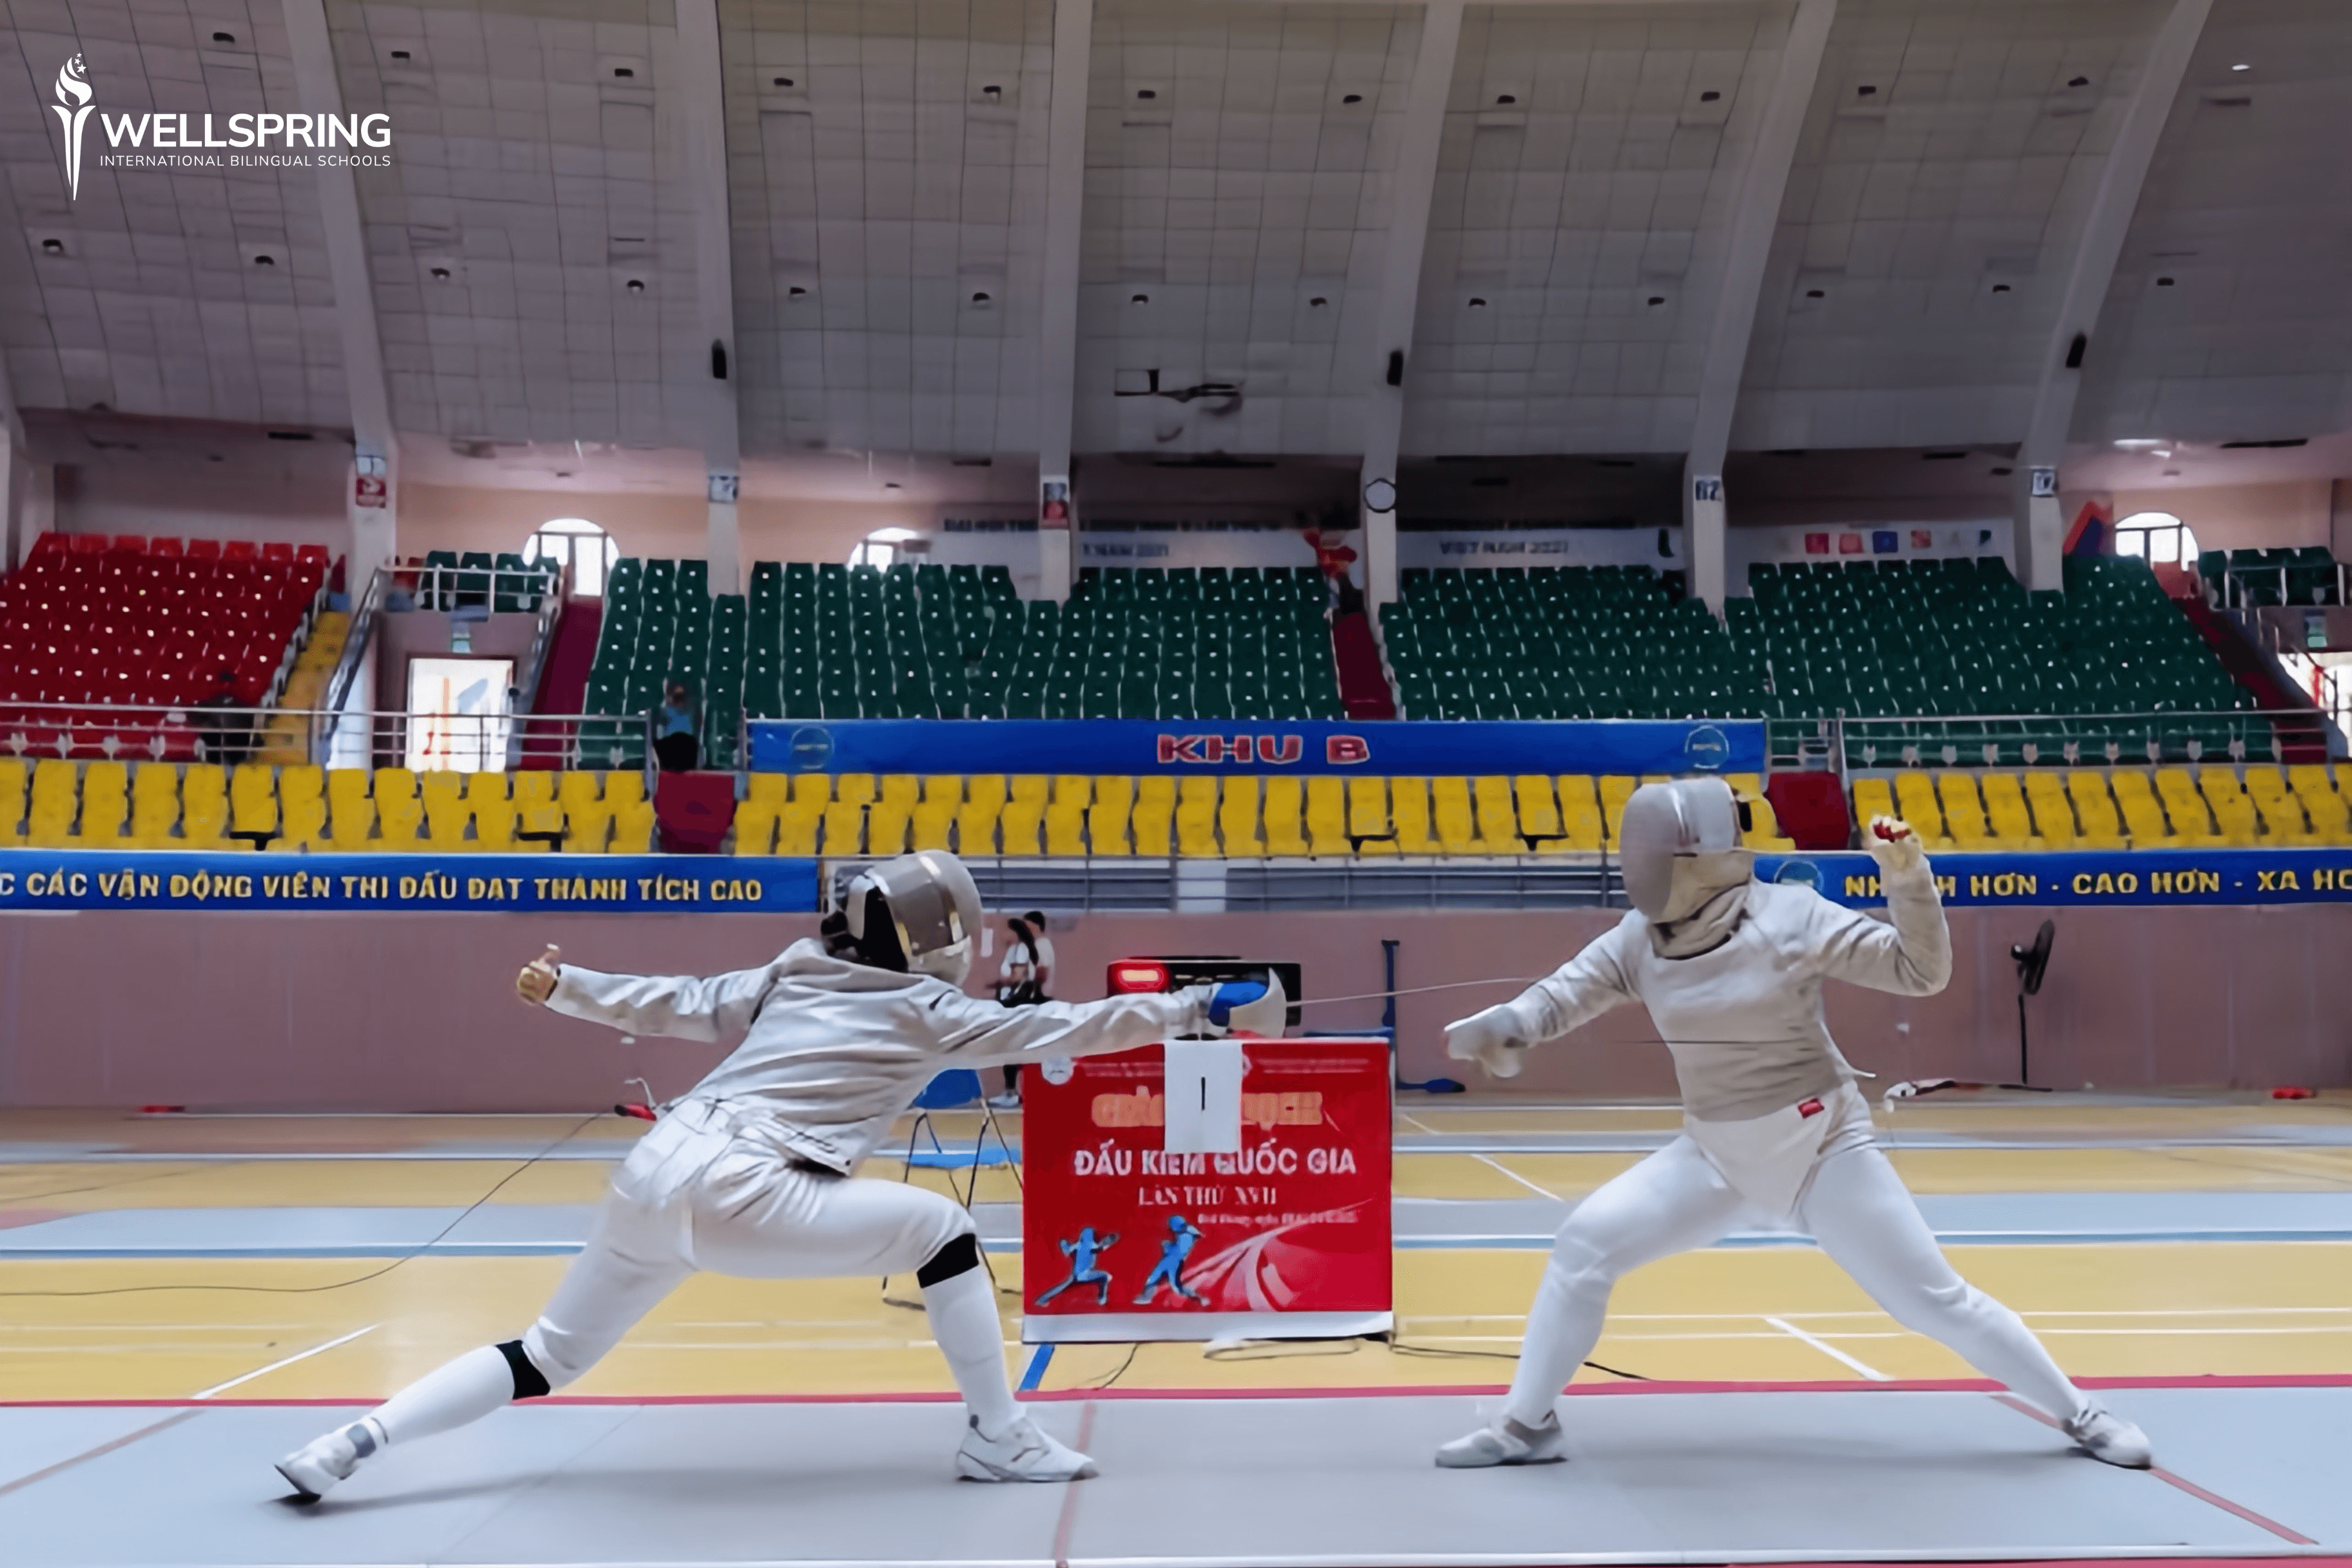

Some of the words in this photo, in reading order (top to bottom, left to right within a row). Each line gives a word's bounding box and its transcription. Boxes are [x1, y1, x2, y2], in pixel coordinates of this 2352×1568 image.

[1157, 734, 1303, 765] KHU
[1326, 734, 1371, 765] B
[26, 867, 87, 896] CÁC
[341, 876, 389, 898] THI
[710, 879, 761, 901] CAO
[1845, 876, 1956, 897] NHH
[2072, 872, 2138, 894] CAO
[2257, 870, 2300, 891] XA
[1307, 1148, 1357, 1175] GIA
